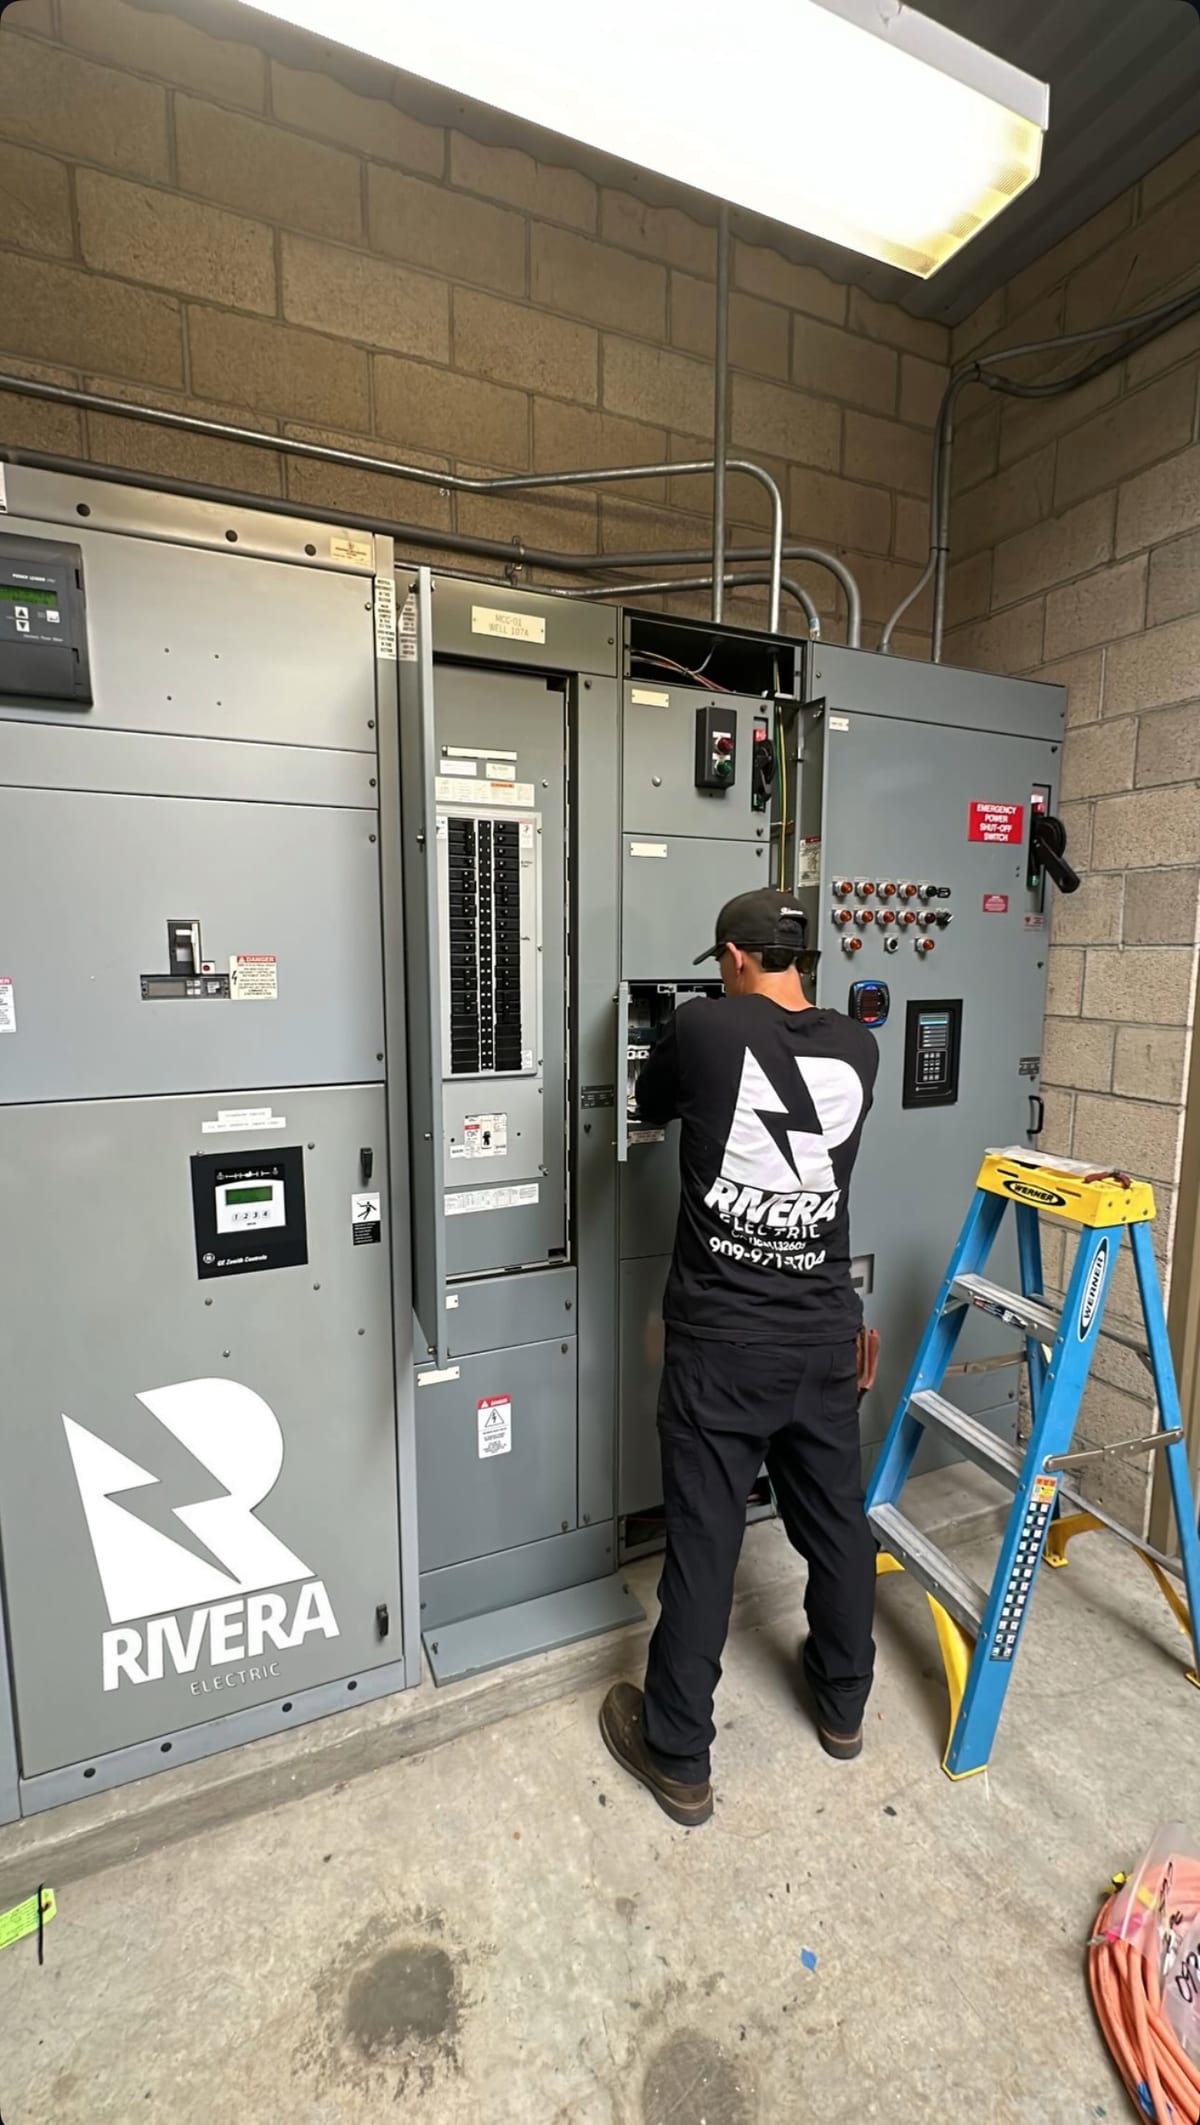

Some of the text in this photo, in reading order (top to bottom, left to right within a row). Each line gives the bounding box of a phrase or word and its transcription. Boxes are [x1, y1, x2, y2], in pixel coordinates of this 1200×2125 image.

[489, 623, 508, 634] WELL
[976, 803, 1017, 814] EMERGENCY
[984, 814, 1009, 823] POWER
[979, 822, 1013, 832] SHUT-OFF
[983, 832, 1009, 842] SWITCH
[1014, 1182, 1055, 1203] WERNER
[704, 1176, 841, 1227] RIVERA
[1083, 1257, 1104, 1319] WERNER
[101, 1580, 341, 1692] RIVERA
[189, 1661, 281, 1696] ELECTRIC
